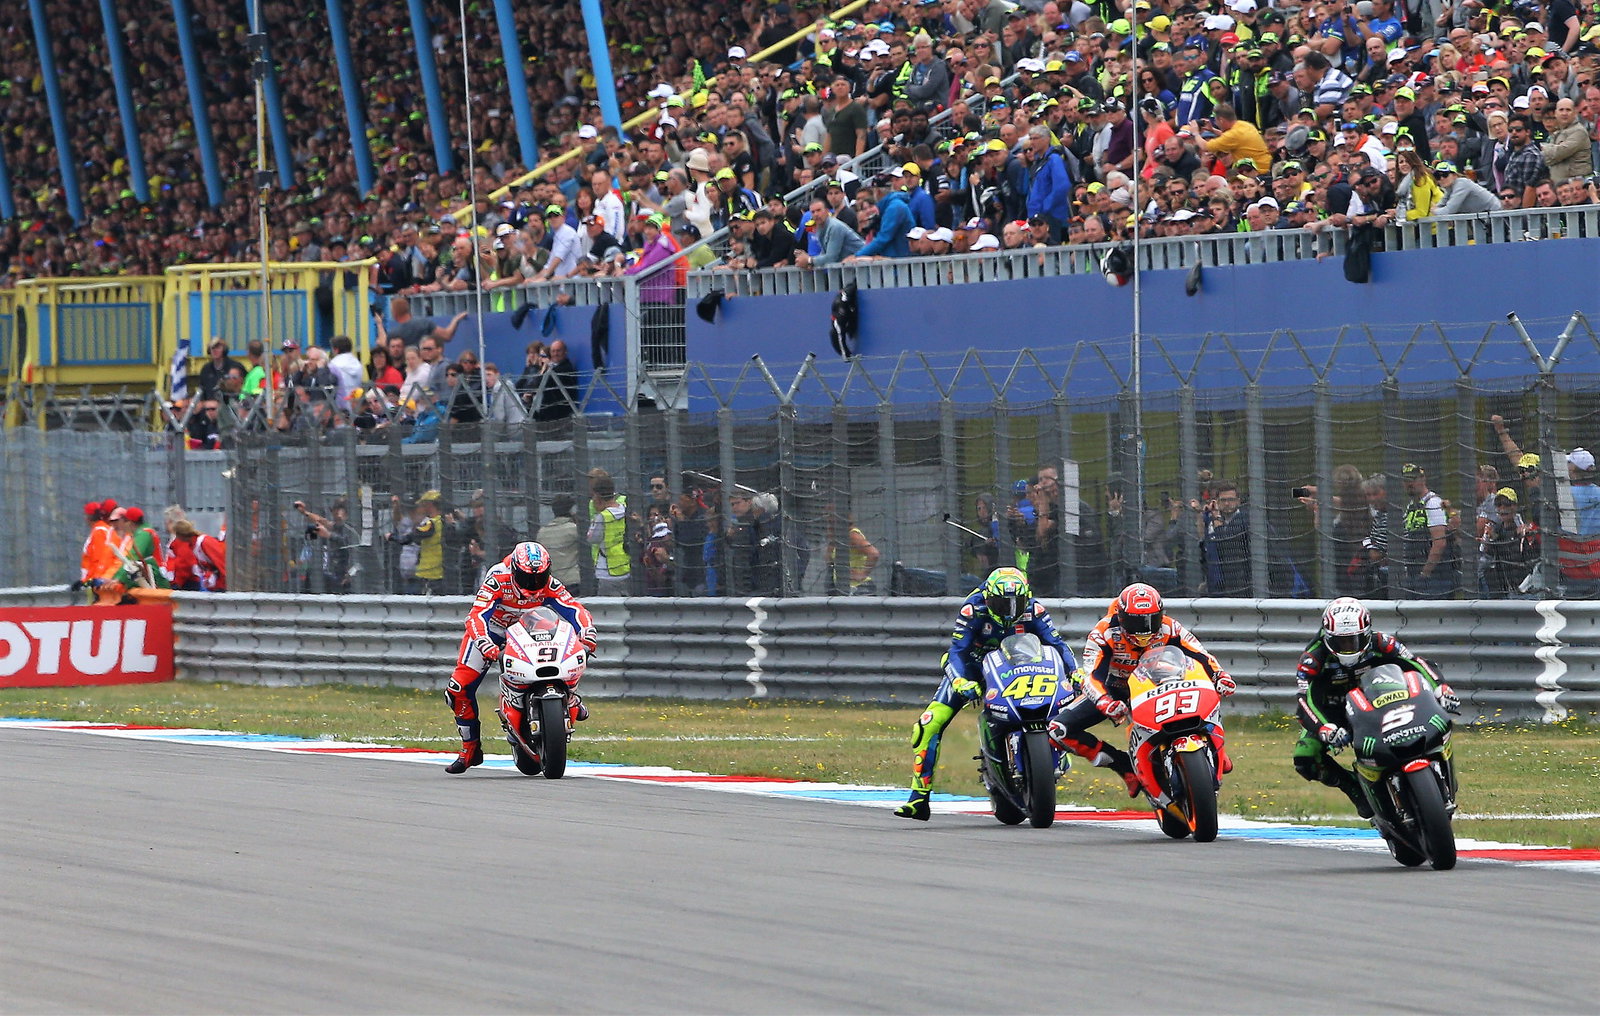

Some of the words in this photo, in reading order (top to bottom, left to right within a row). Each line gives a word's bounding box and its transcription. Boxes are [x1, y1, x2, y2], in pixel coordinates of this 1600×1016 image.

[0, 620, 158, 676] OTUL
[537, 647, 558, 663] 9
[1013, 665, 1055, 675] movistar
[1002, 674, 1059, 700] 46
[1146, 681, 1199, 699] REPSOL
[1154, 689, 1201, 724] 93
[1382, 725, 1428, 744] MONSTER
